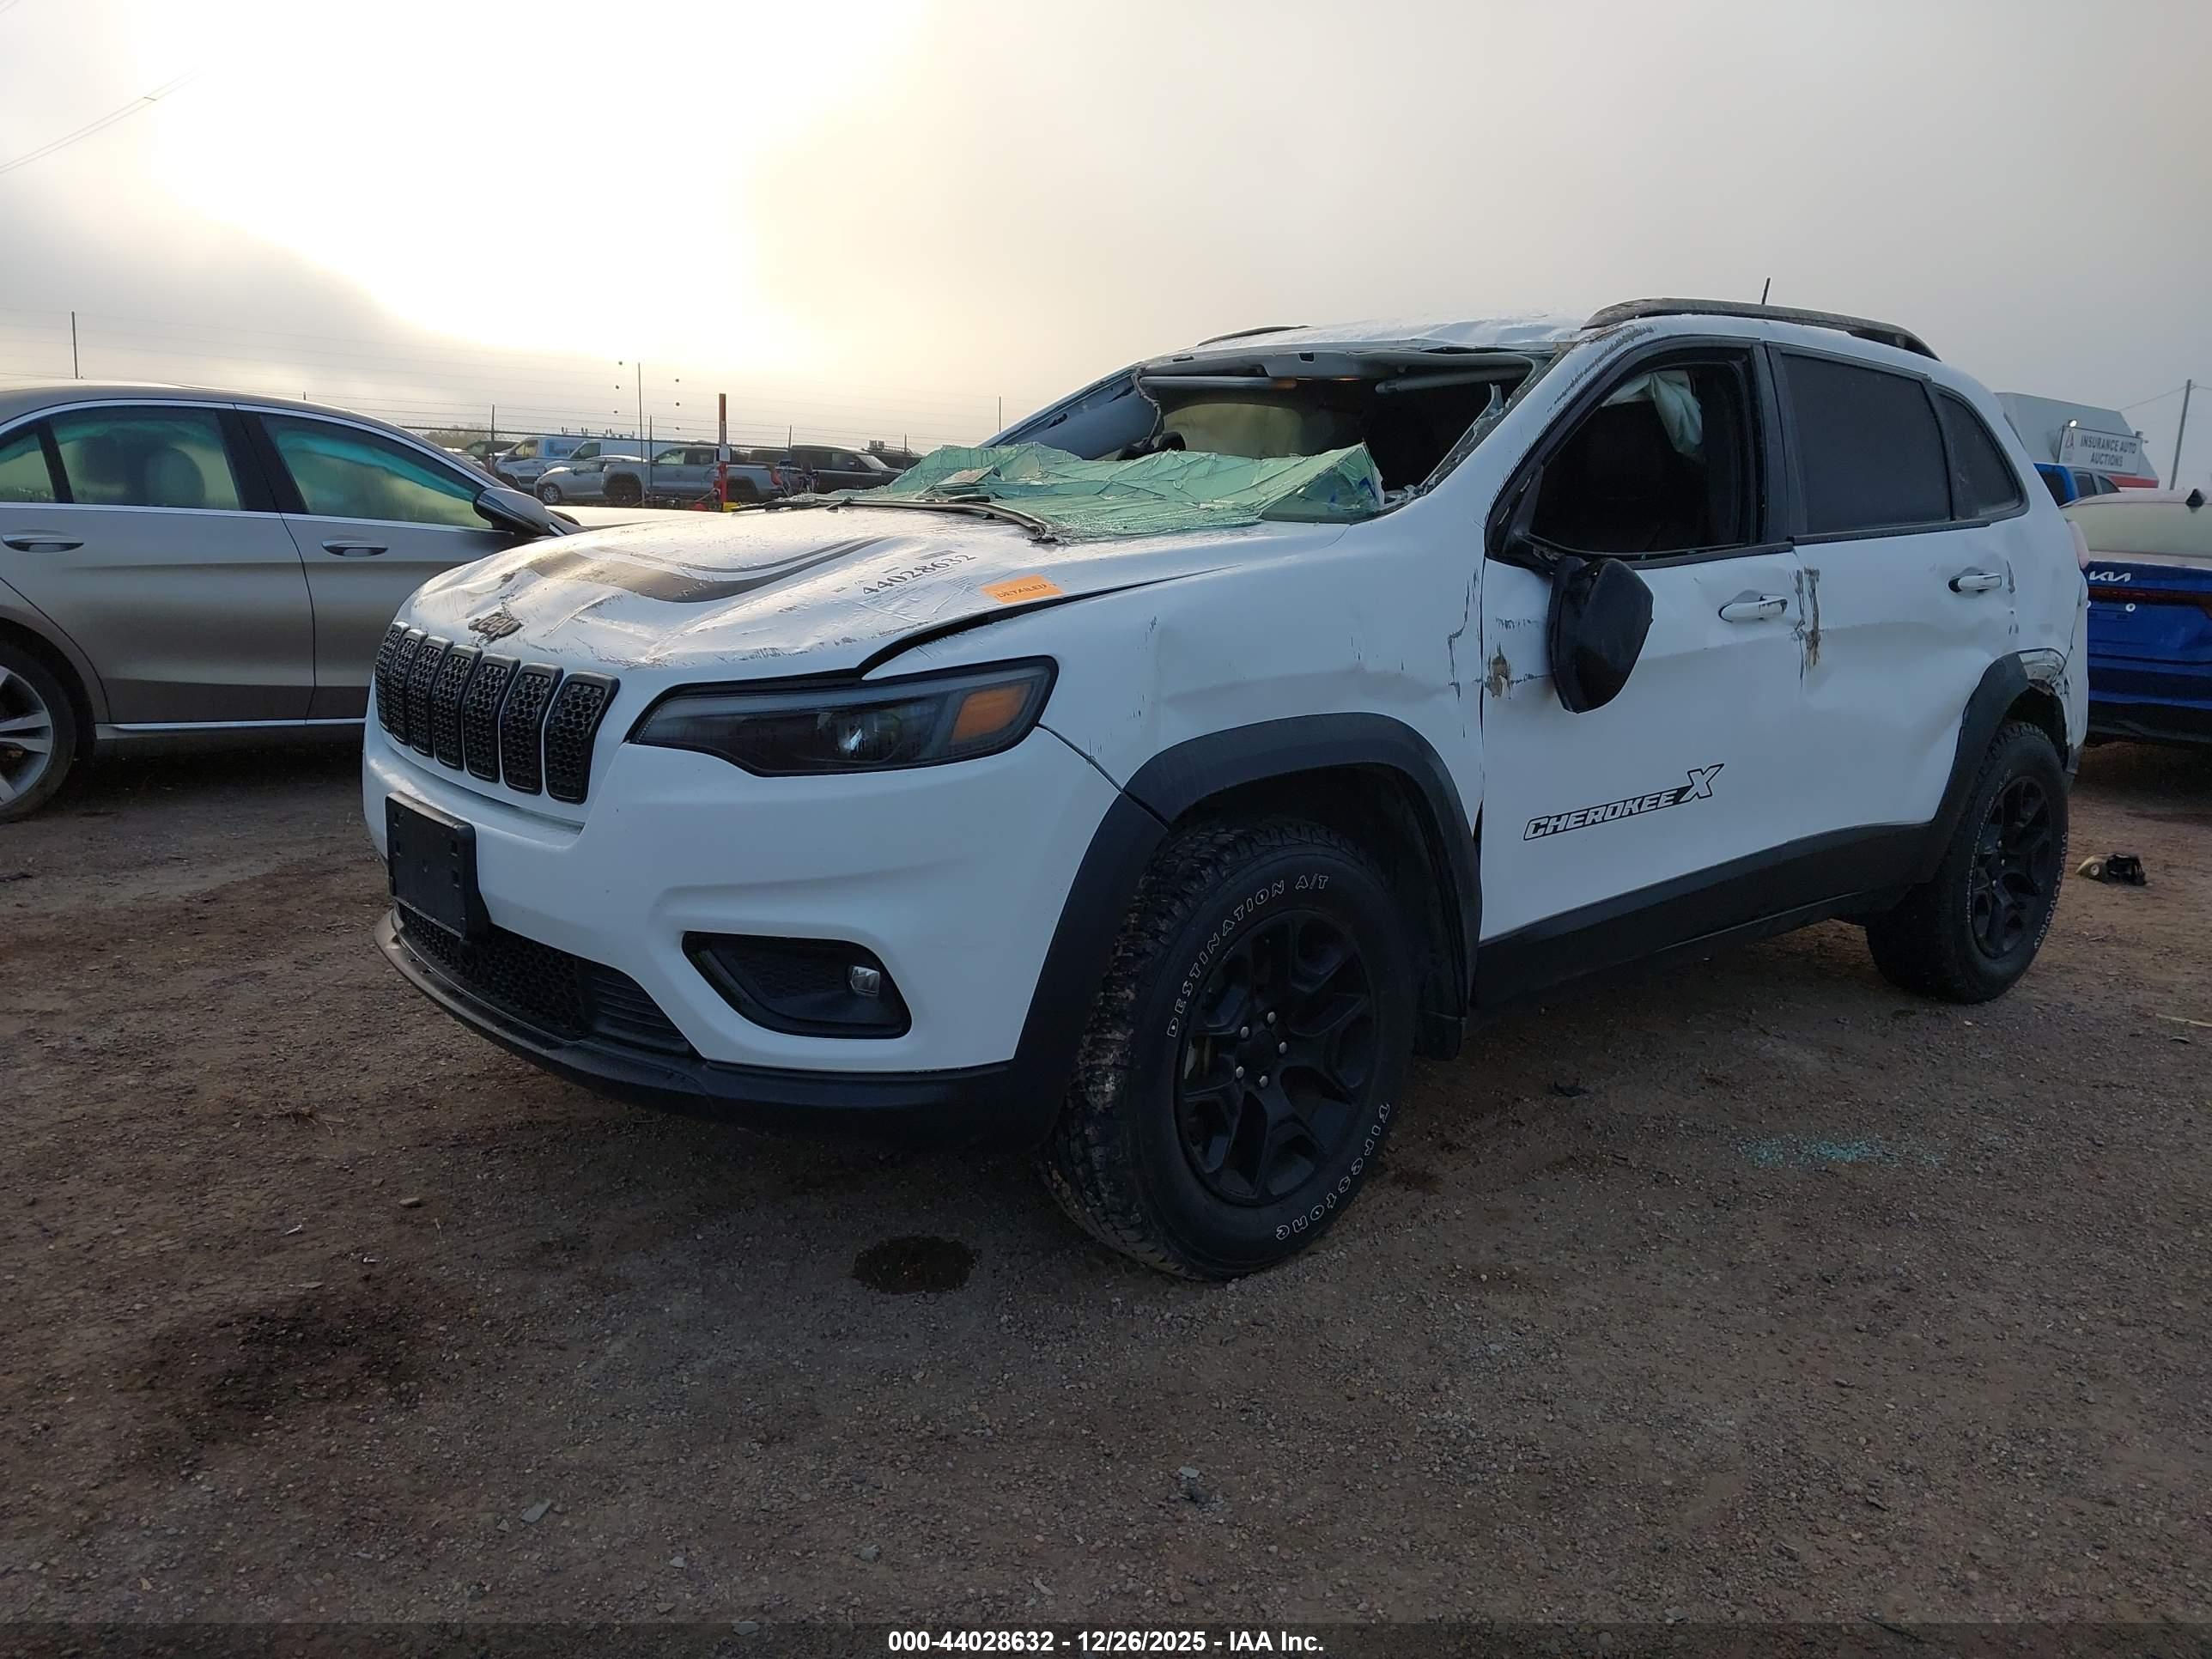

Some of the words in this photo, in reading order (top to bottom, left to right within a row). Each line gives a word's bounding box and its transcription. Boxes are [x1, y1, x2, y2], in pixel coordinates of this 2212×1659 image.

[2081, 434, 2119, 453] INSURANCE
[2120, 440, 2136, 454] AUTO
[2091, 453, 2124, 467] AUCTIONS
[861, 554, 976, 596] 44028632
[2088, 570, 2131, 582] KIA
[996, 583, 1048, 598] DETAILED
[1524, 788, 1679, 840] CHEROKEE
[1167, 879, 1285, 1037] DESTINATION
[1295, 872, 1329, 890] A/T
